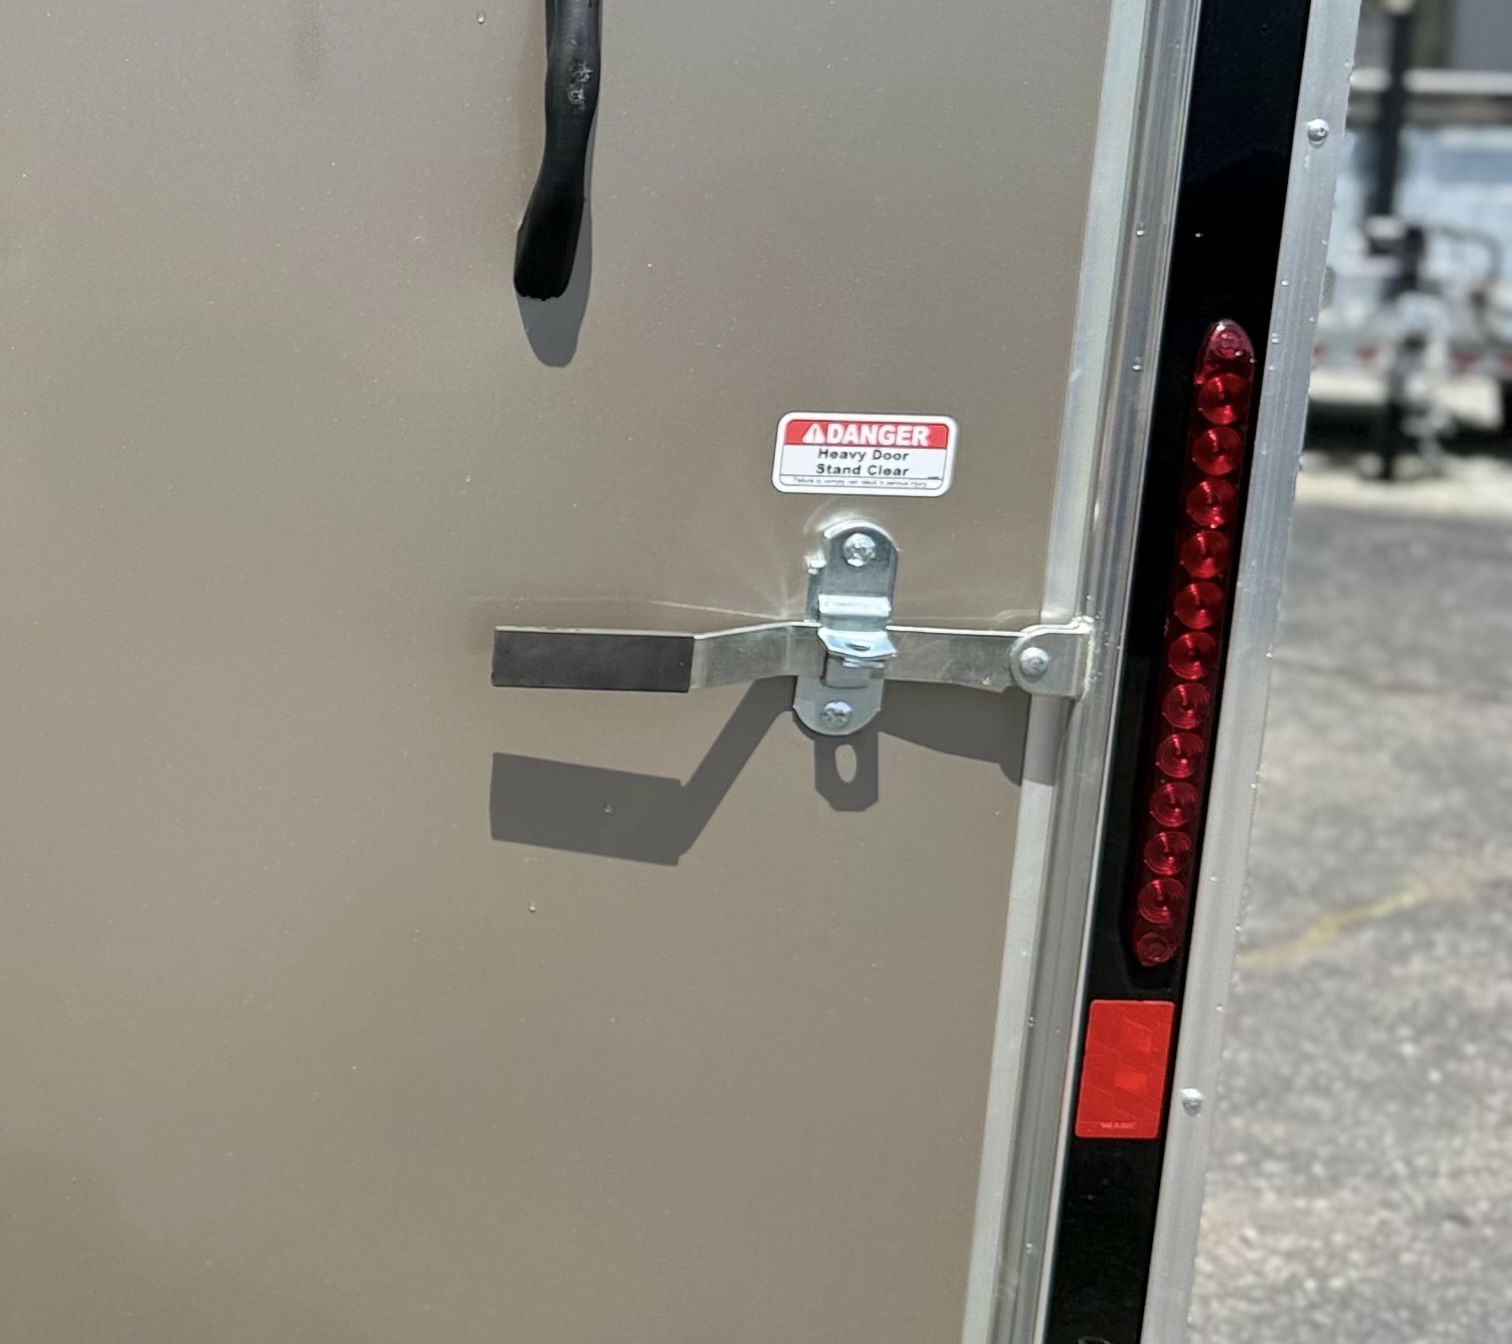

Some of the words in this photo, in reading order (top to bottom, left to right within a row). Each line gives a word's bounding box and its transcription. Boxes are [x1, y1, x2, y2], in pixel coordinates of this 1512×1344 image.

[826, 423, 930, 446] DANGER
[817, 448, 866, 462] Heavy
[872, 450, 909, 461] Door
[816, 463, 861, 475] Stand
[867, 464, 909, 476] Clear
